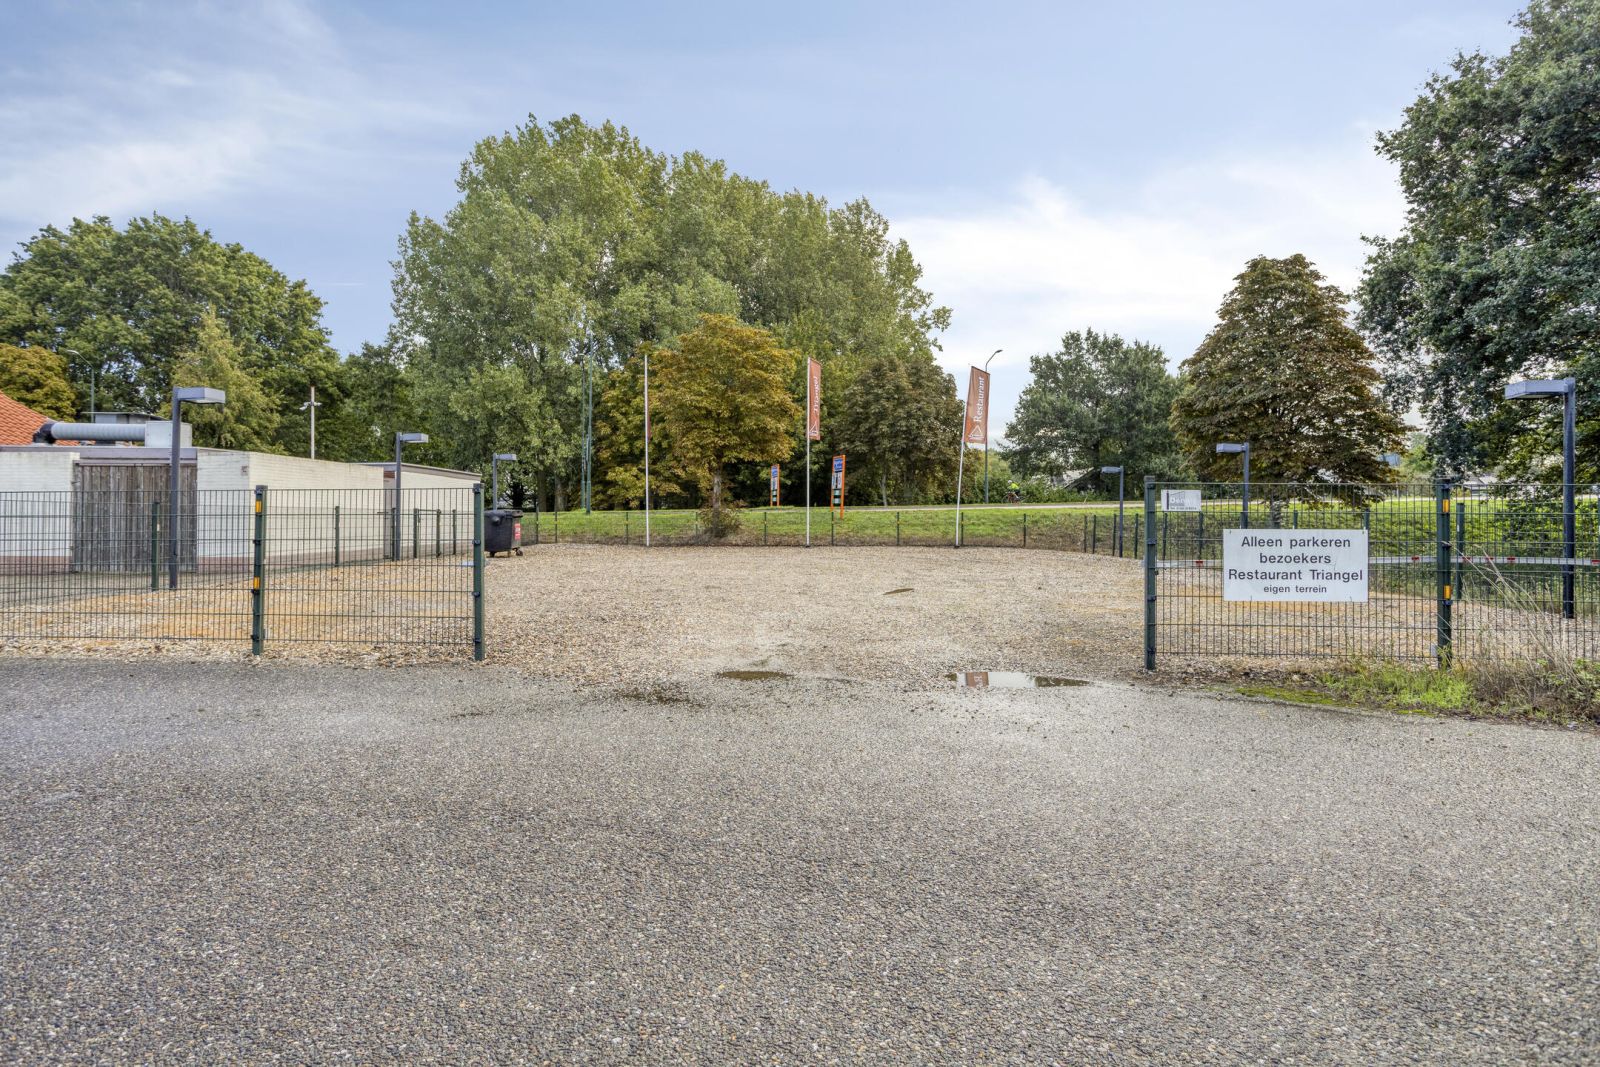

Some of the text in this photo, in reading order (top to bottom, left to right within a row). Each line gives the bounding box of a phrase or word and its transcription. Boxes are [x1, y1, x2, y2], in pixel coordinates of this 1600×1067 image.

[973, 377, 985, 422] Restaurant
[1241, 536, 1351, 549] Alleen parkeren
[1259, 552, 1332, 564] bezoekers
[1228, 569, 1363, 583] Restaurant Triangel
[1263, 585, 1327, 595] eigen terrein
